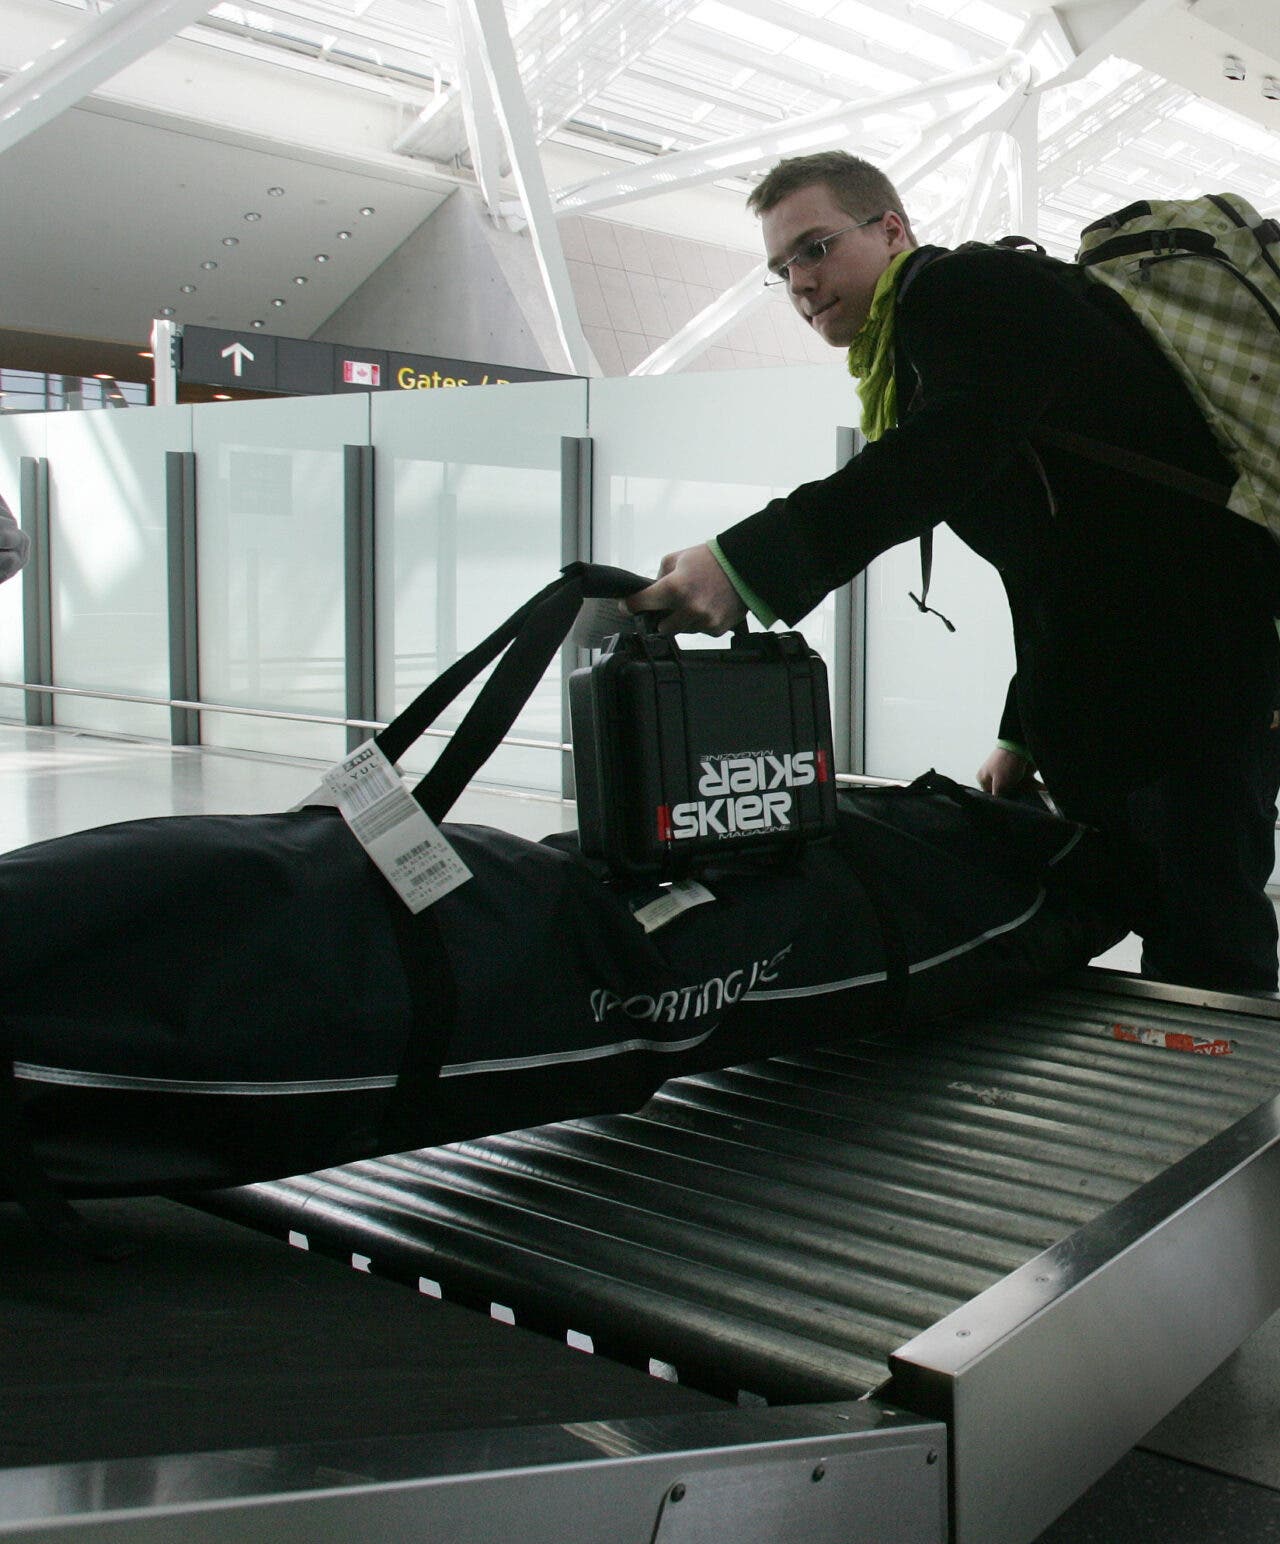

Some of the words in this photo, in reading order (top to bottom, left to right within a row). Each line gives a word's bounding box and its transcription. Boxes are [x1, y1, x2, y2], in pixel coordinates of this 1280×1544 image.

[397, 367, 468, 390] Gates
[351, 762, 378, 780] YUL
[718, 826, 790, 840] MAGAZINE
